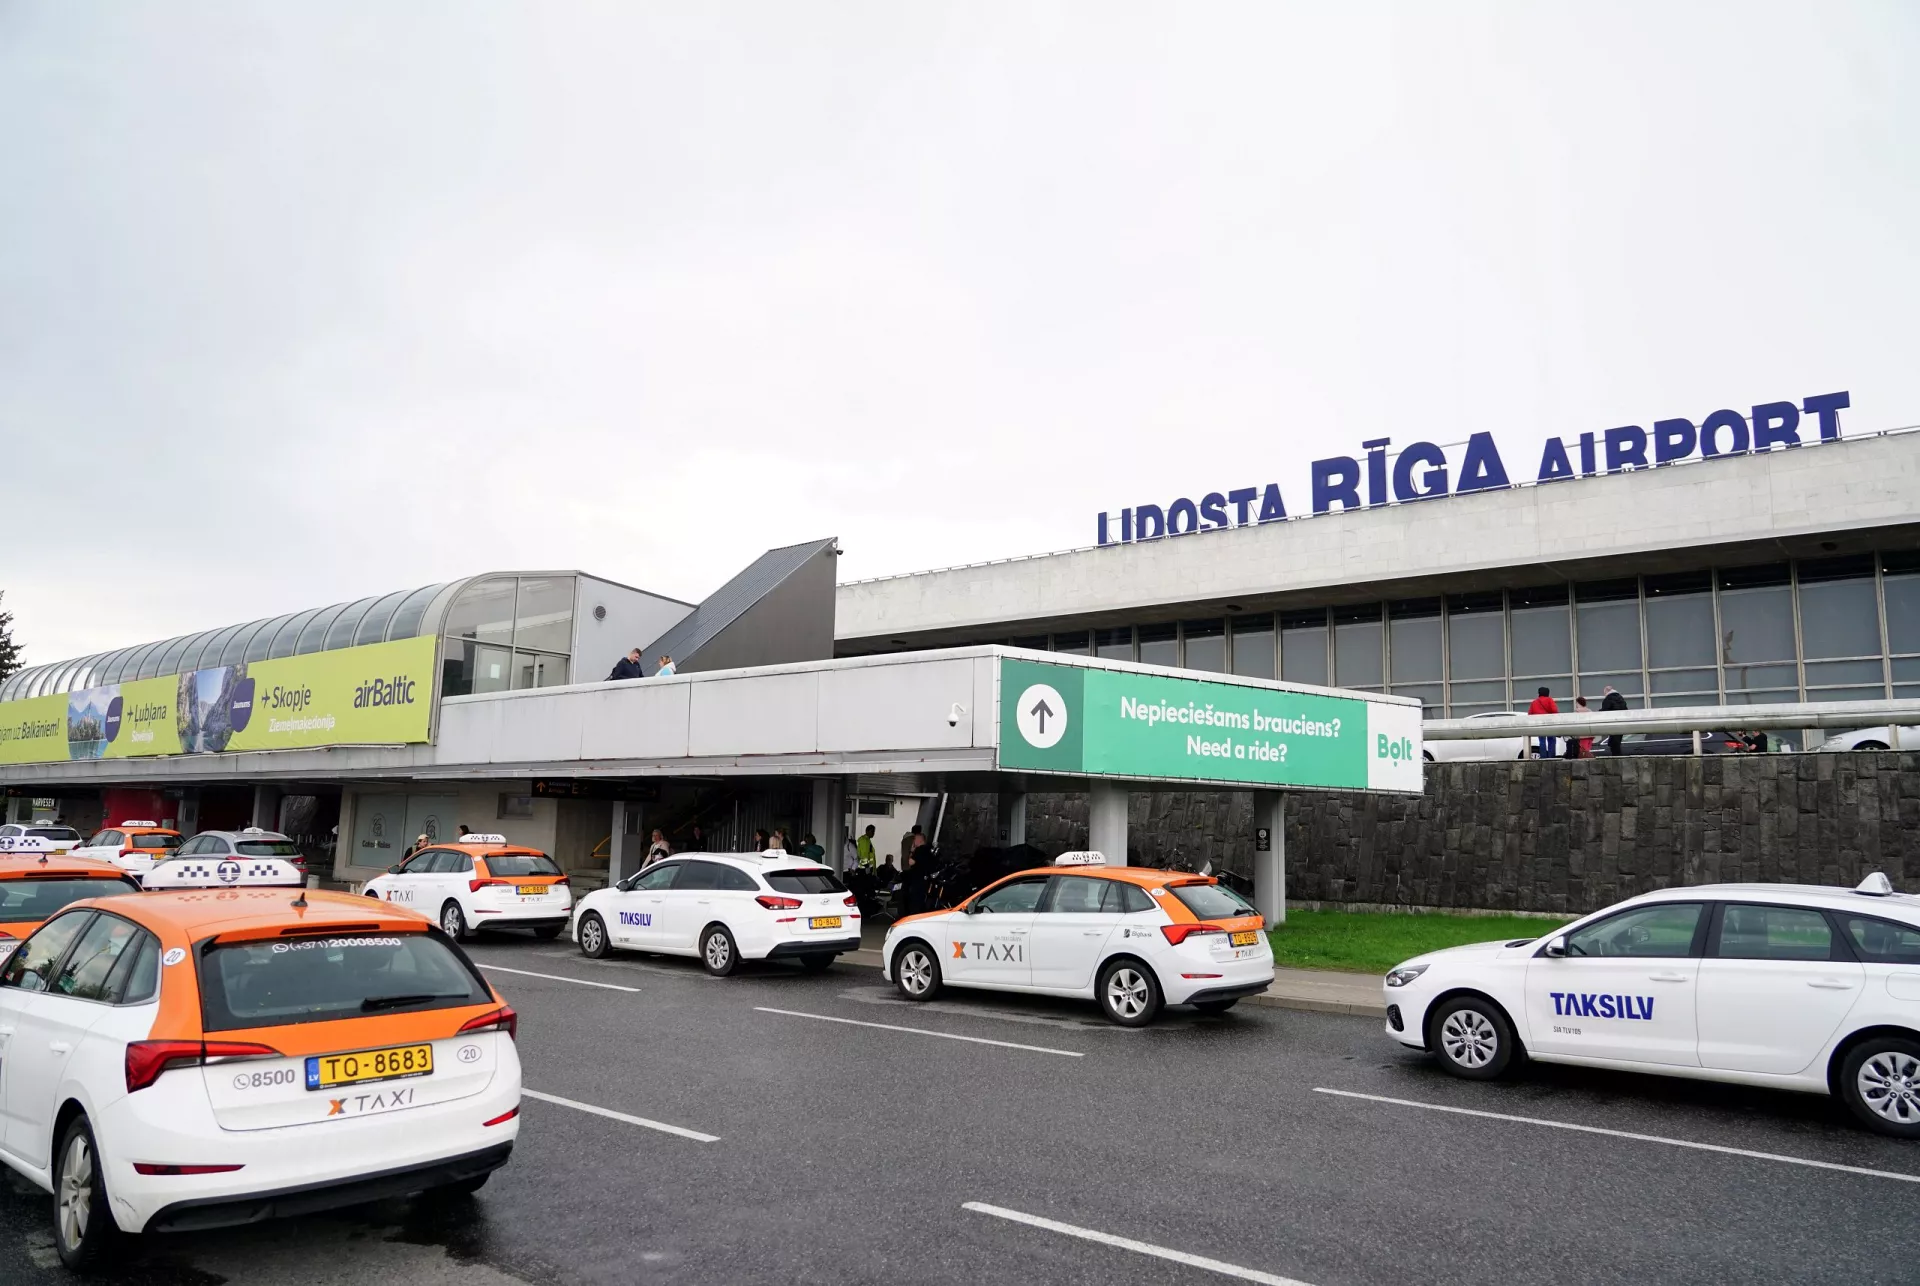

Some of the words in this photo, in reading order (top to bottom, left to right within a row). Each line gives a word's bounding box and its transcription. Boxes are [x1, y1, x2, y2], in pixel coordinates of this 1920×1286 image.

[1098, 483, 1288, 548] LIDOSTA
[1311, 431, 1510, 517] RĪGA
[1536, 391, 1850, 485] AIRPORT
[272, 684, 311, 712] Skopje
[353, 675, 416, 709] airBaltic
[1120, 696, 1250, 730] Nepieciešams
[1253, 707, 1341, 738] brauciens?
[1187, 735, 1231, 758] Need
[1234, 743, 1245, 759] a
[1248, 740, 1288, 762] ride?
[1376, 733, 1413, 768] Bolt
[393, 890, 415, 902] TAXI
[619, 911, 652, 927] TAKSILV
[329, 937, 401, 948] 20008500
[972, 942, 1023, 962] TAXI
[165, 950, 181, 963] 20
[1549, 992, 1654, 1020] TAKSILV
[1553, 1025, 1562, 1033] SIA
[325, 1048, 428, 1080] TQ-8683
[463, 1048, 476, 1060] 20
[251, 1069, 296, 1088] 8500
[308, 1073, 319, 1082] LV
[355, 1088, 414, 1112] TAXI
